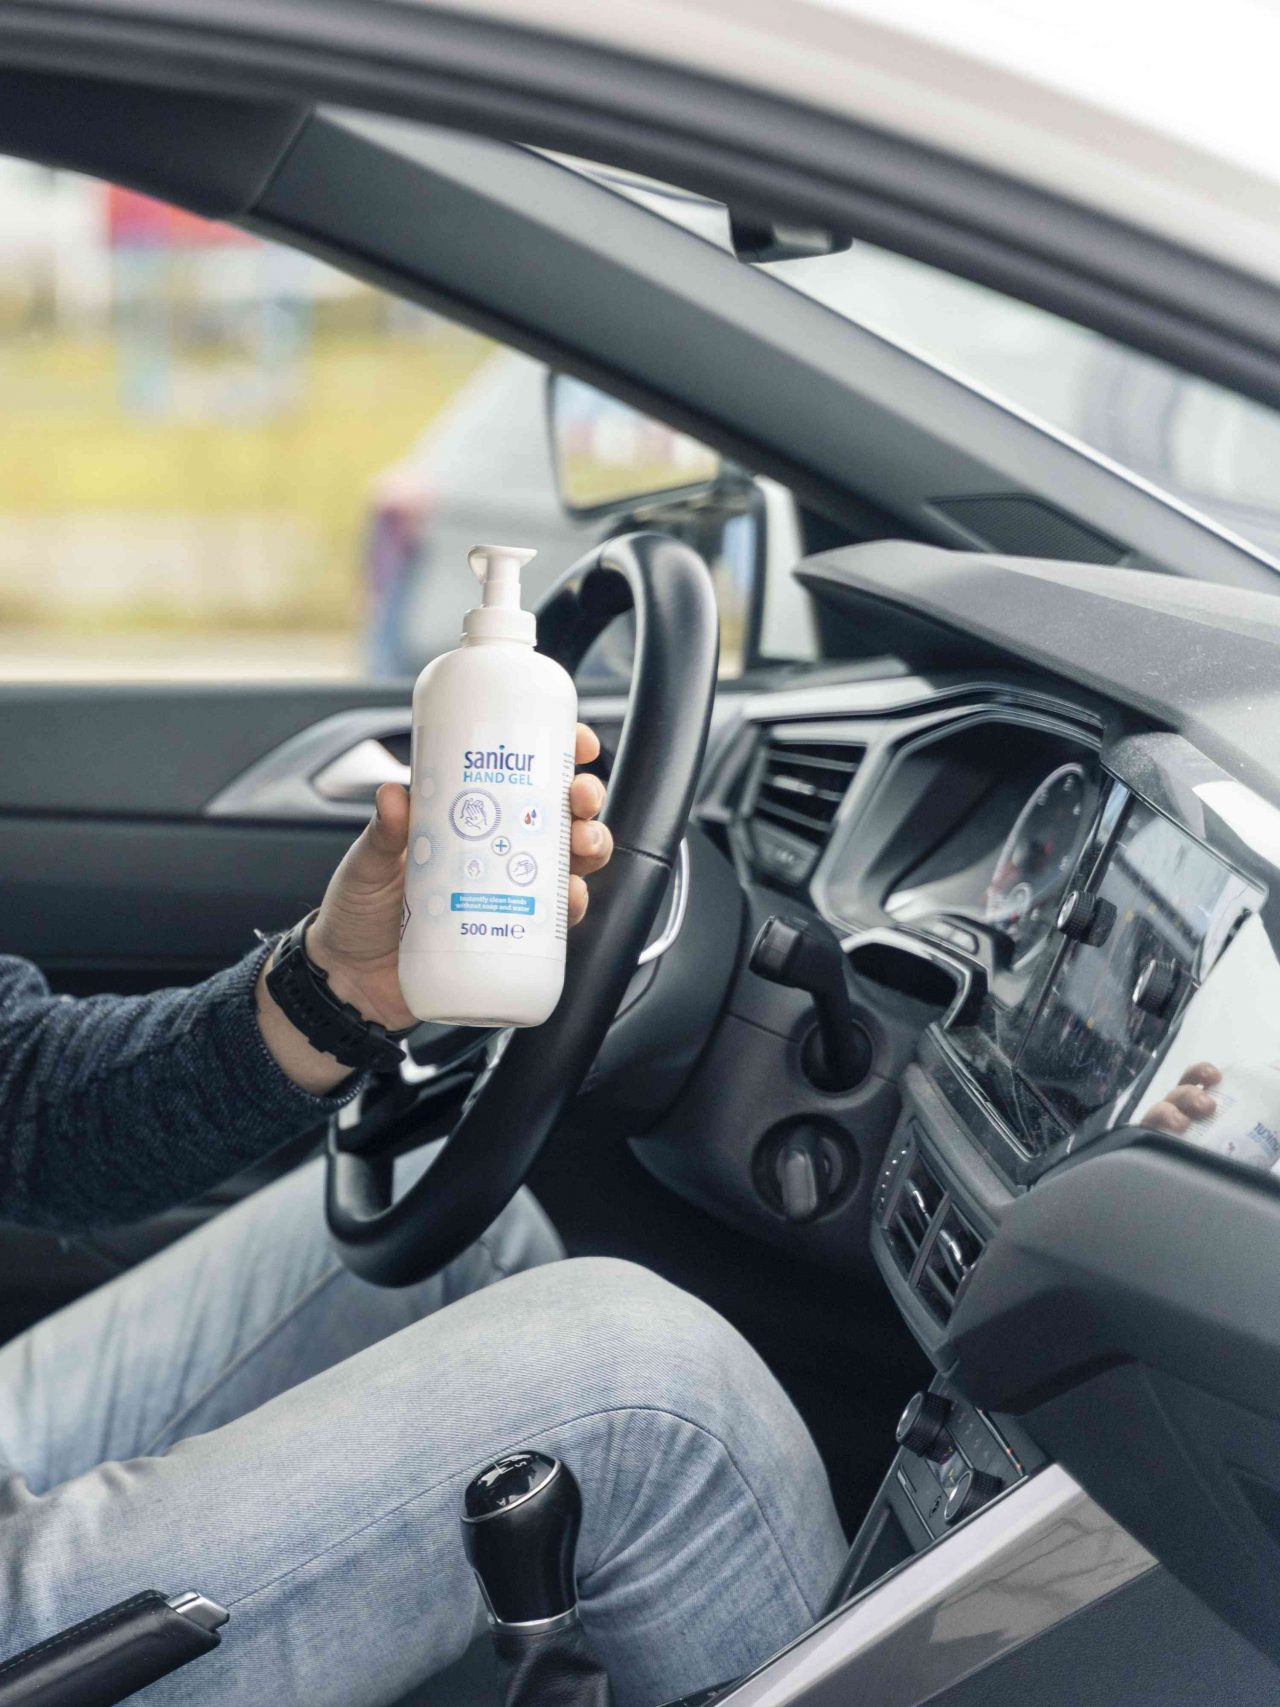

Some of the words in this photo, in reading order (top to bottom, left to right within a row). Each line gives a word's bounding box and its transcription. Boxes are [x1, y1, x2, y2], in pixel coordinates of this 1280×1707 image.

[464, 744, 535, 772] sanicur
[463, 771, 505, 784] HAND
[508, 773, 534, 786] GEL
[460, 922, 487, 936] 500
[491, 923, 509, 937] ml
